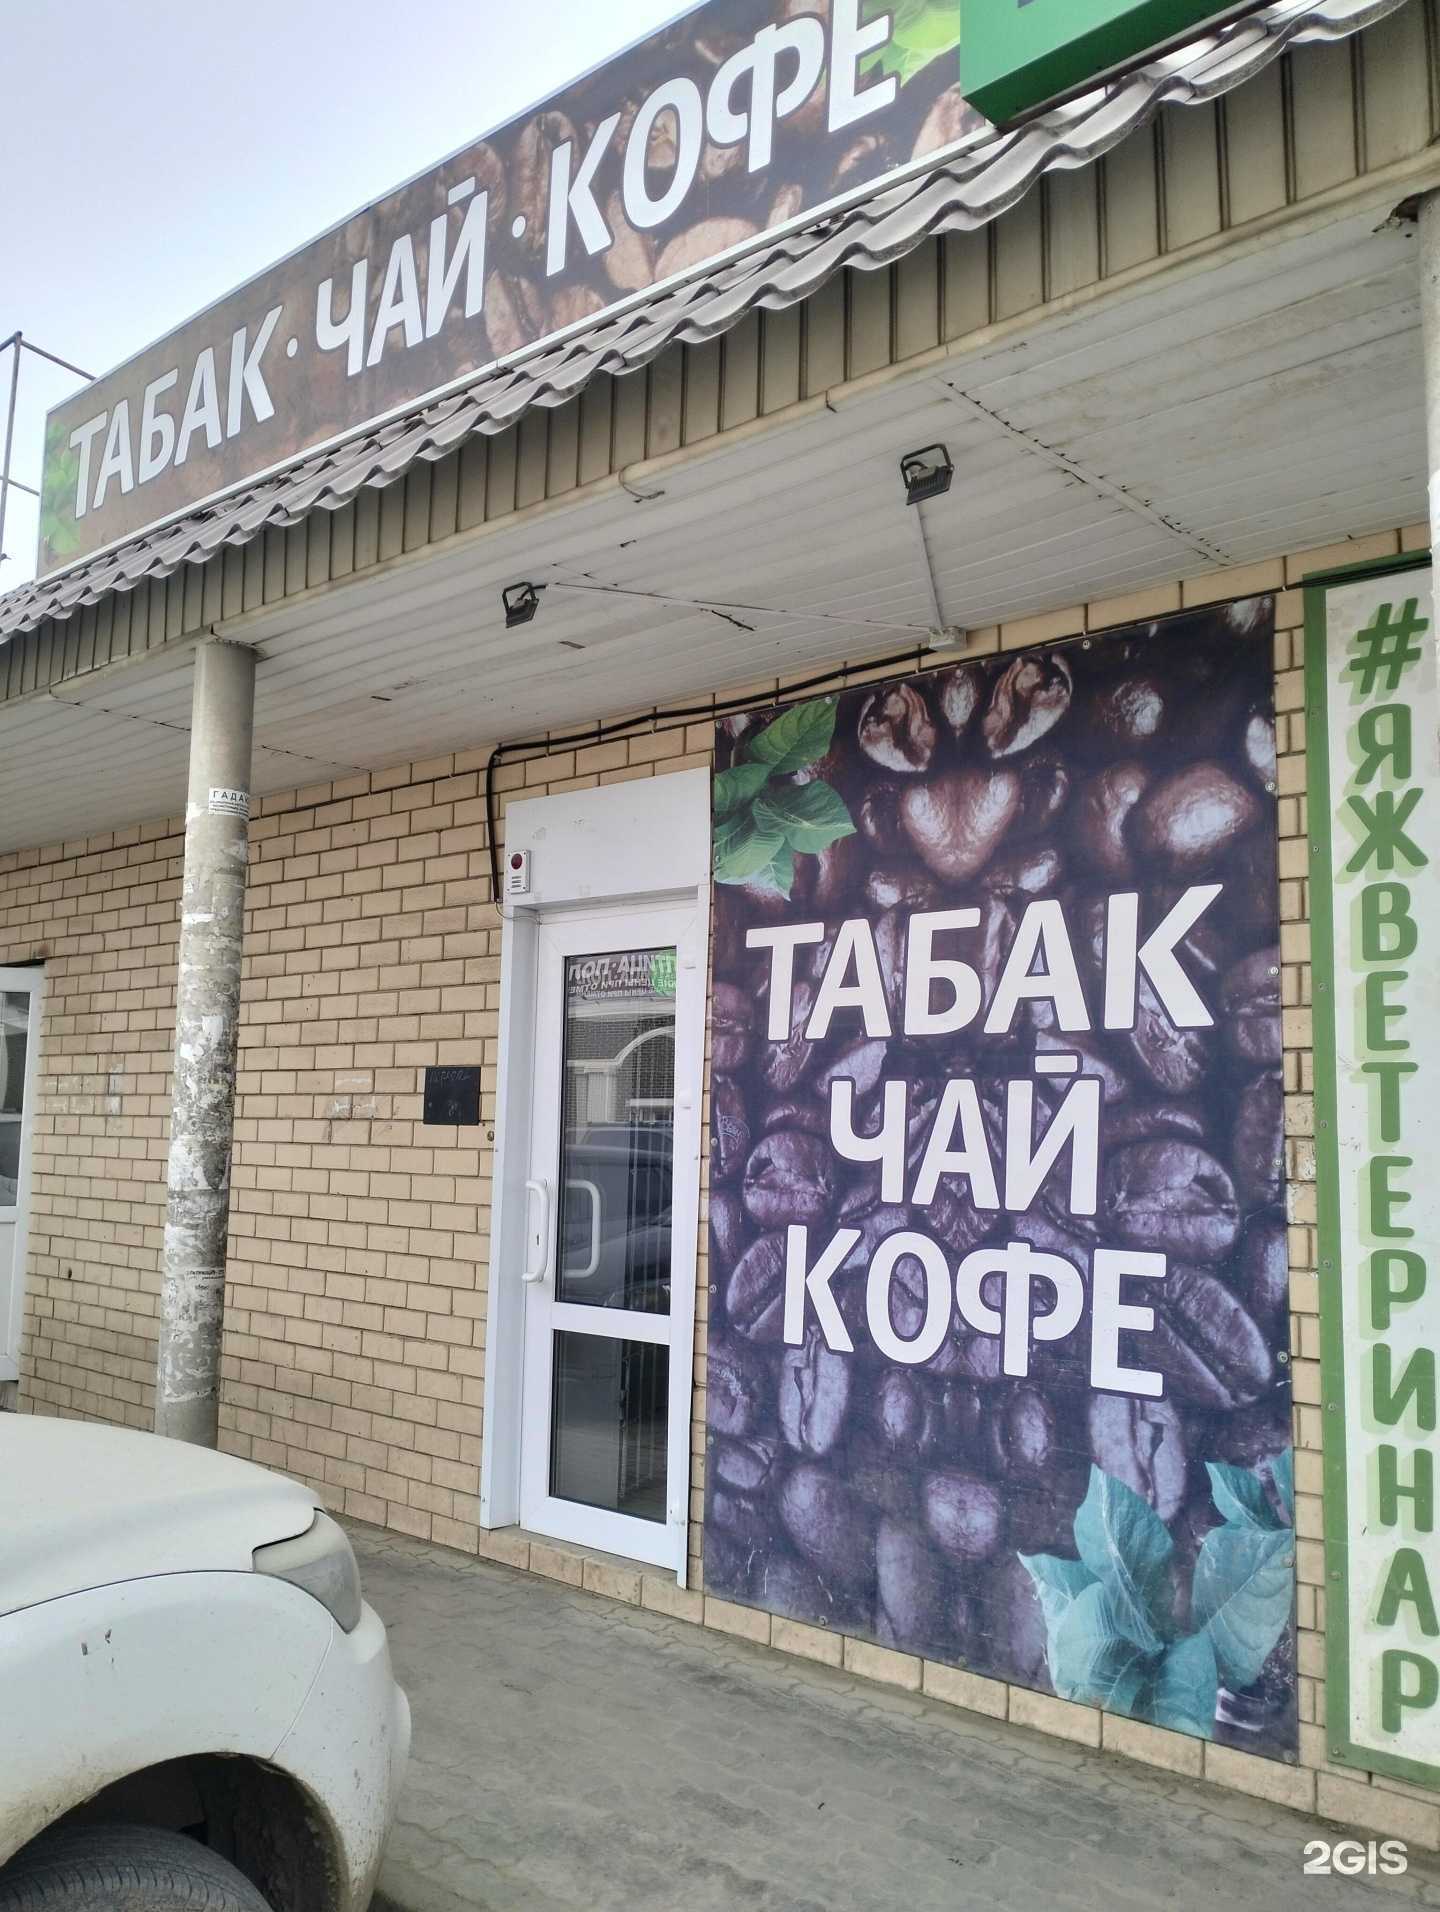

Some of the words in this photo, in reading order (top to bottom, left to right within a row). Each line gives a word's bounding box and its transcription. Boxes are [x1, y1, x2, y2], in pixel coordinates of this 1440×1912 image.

[69, 305, 283, 519] ТАБАК
[316, 177, 488, 377] ЧАЙ
[546, 0, 896, 277] КОФЕ
[746, 884, 1223, 1040] ТАБАК
[830, 1055, 1101, 1215] ЧАЙ
[783, 1224, 1167, 1397] КОФЕ
